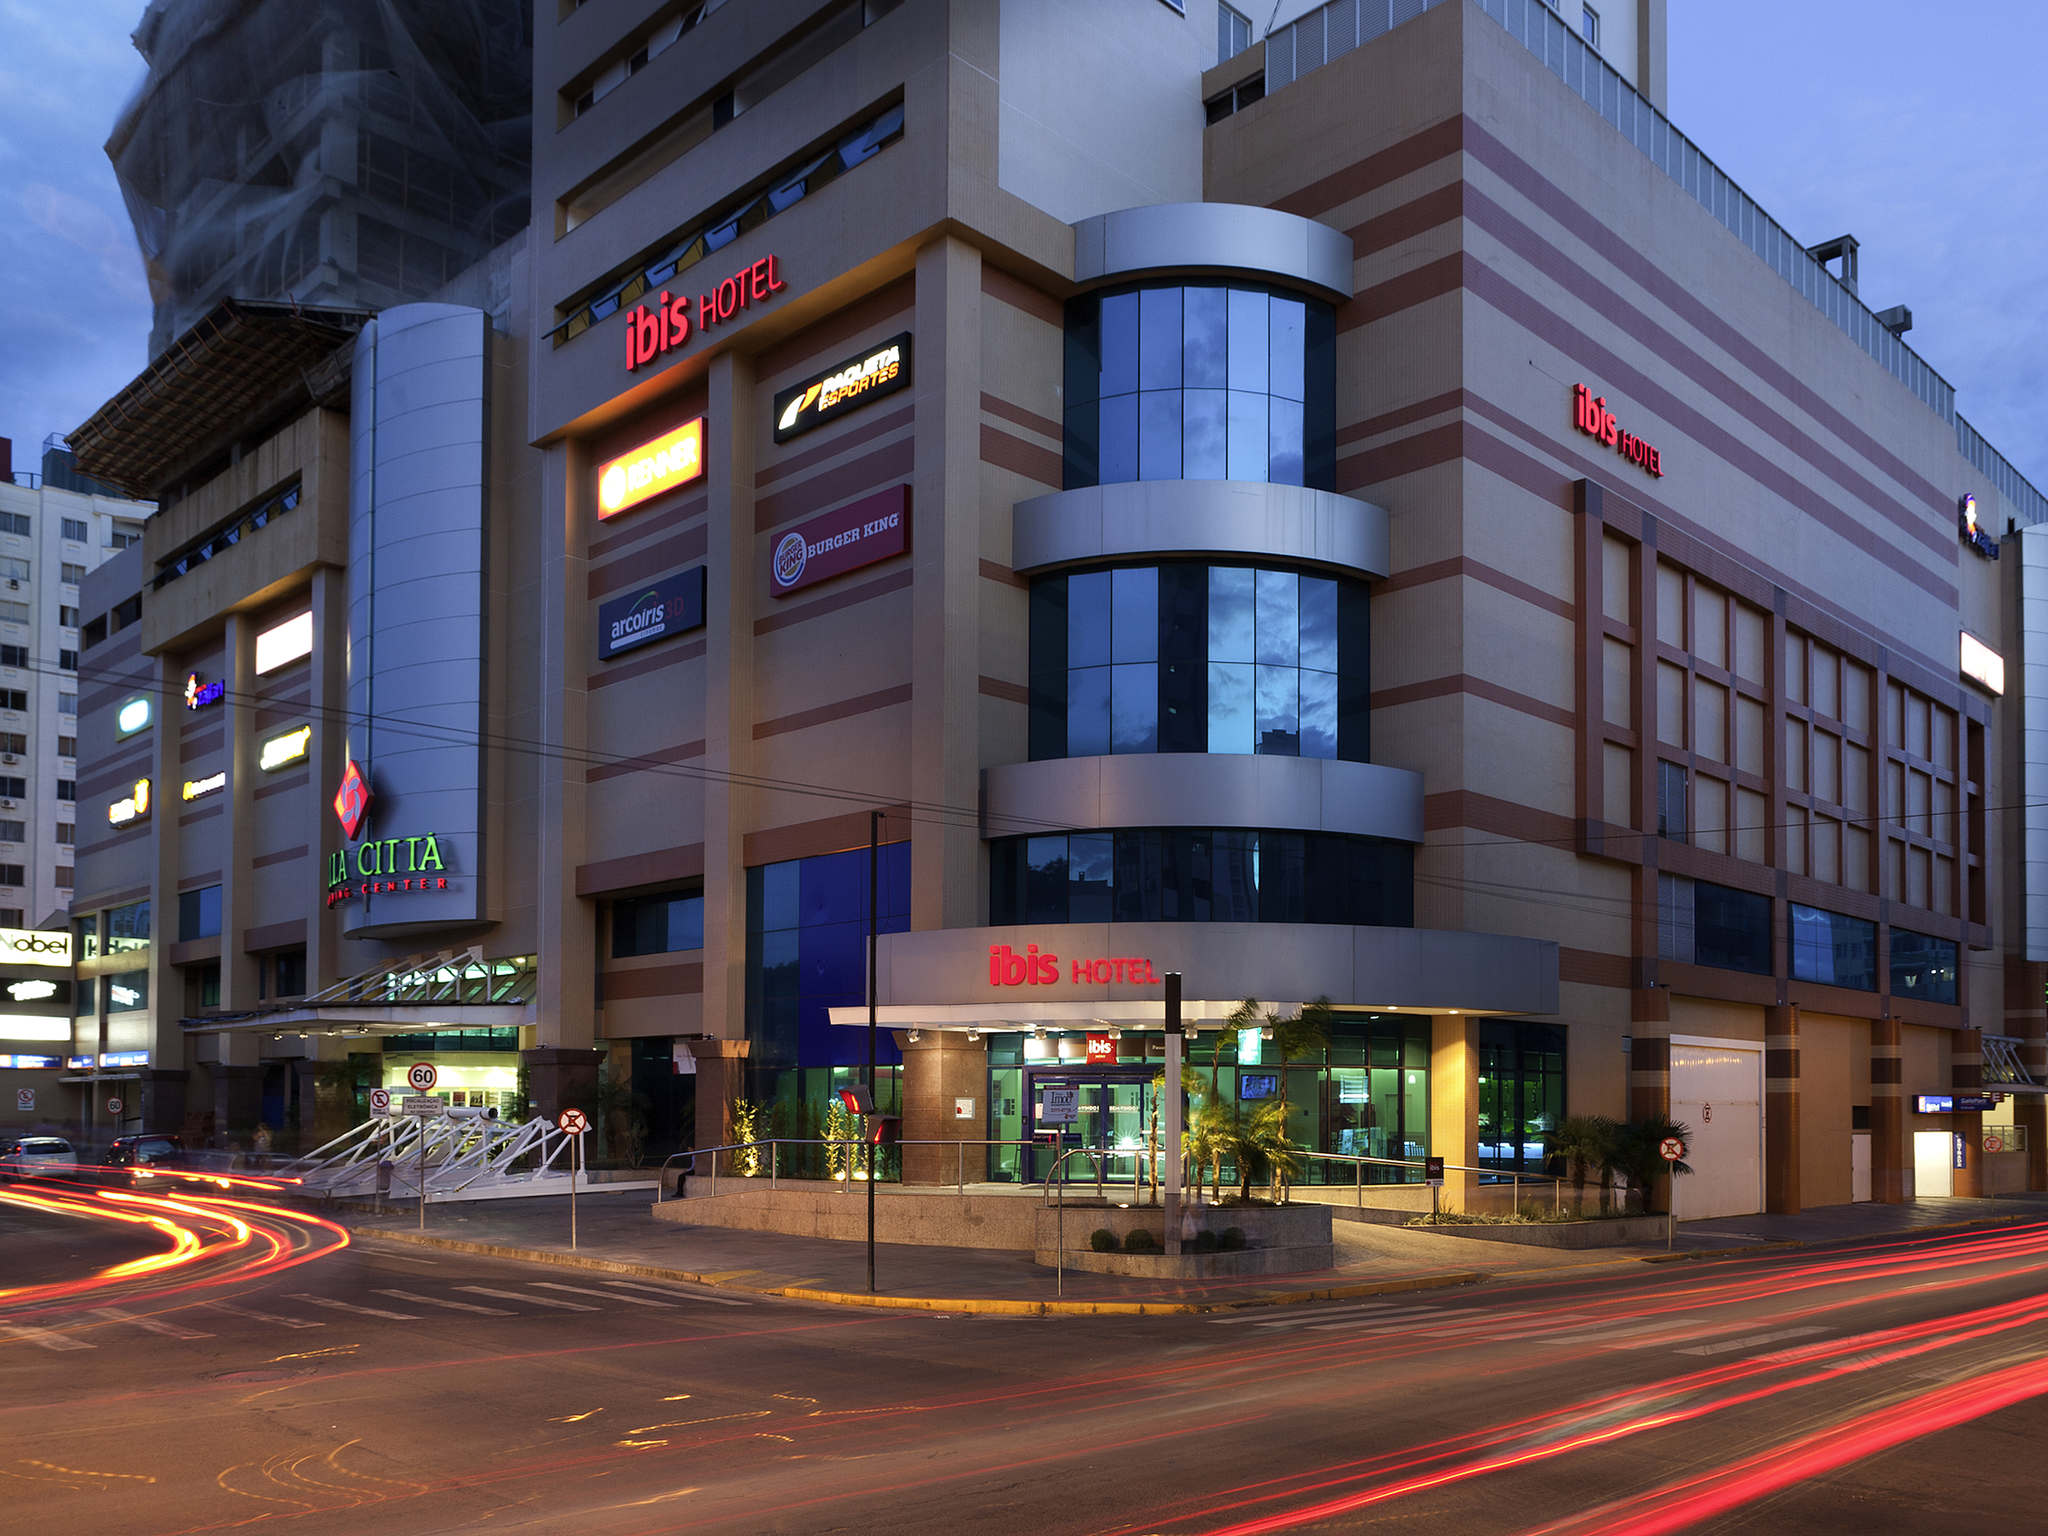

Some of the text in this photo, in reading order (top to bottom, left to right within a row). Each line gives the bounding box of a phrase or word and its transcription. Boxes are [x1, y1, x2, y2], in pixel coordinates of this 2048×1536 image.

[625, 254, 787, 371] ibis HOTEL
[823, 362, 900, 410] ESPORTES
[1573, 383, 1664, 478] ibis HOTEL
[628, 437, 697, 491] RENNER
[807, 512, 899, 558] BURGER KING
[611, 604, 664, 639] arcoiris
[361, 877, 447, 895] CENTER
[989, 944, 1161, 986] ibis HOTEL
[1088, 1039, 1112, 1054] ibis
[413, 1069, 433, 1083] 60
[109, 1101, 121, 1110] 60
